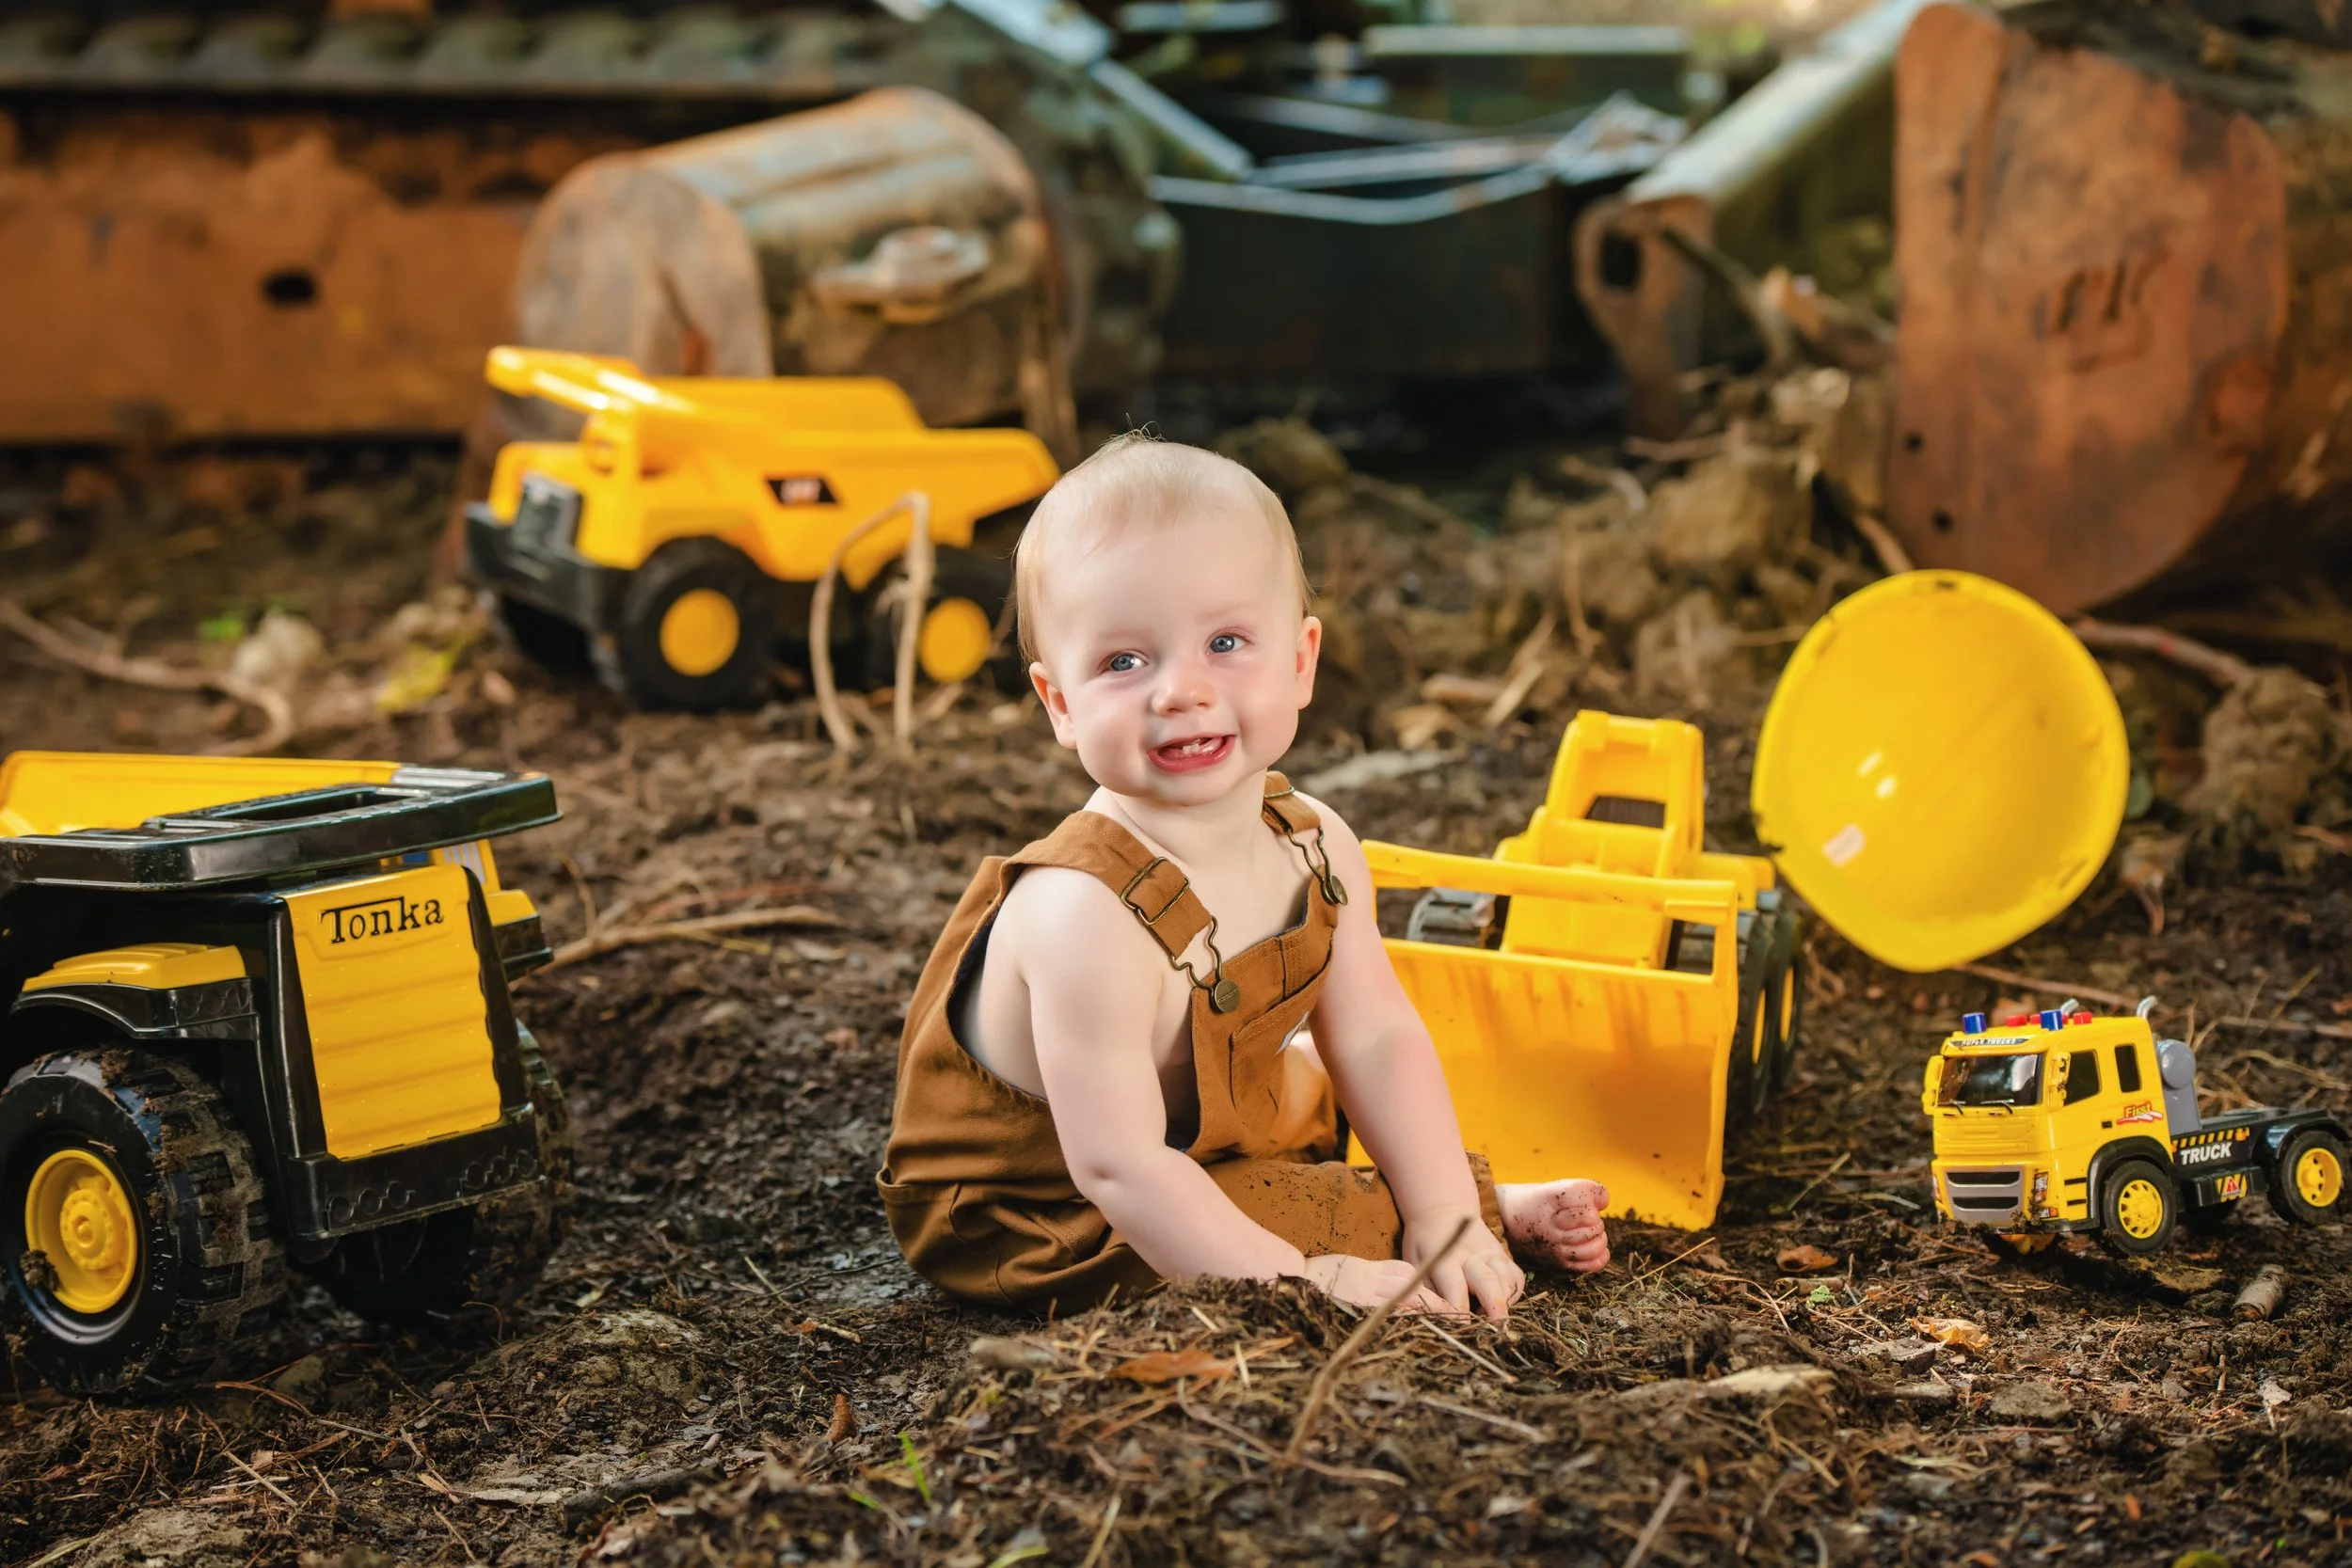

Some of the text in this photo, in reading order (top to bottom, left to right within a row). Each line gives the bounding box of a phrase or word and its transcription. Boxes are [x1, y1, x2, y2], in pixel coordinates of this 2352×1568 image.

[321, 896, 444, 943] Tonka
[2123, 1101, 2153, 1119] First
[2180, 1141, 2233, 1165] TRUCK
